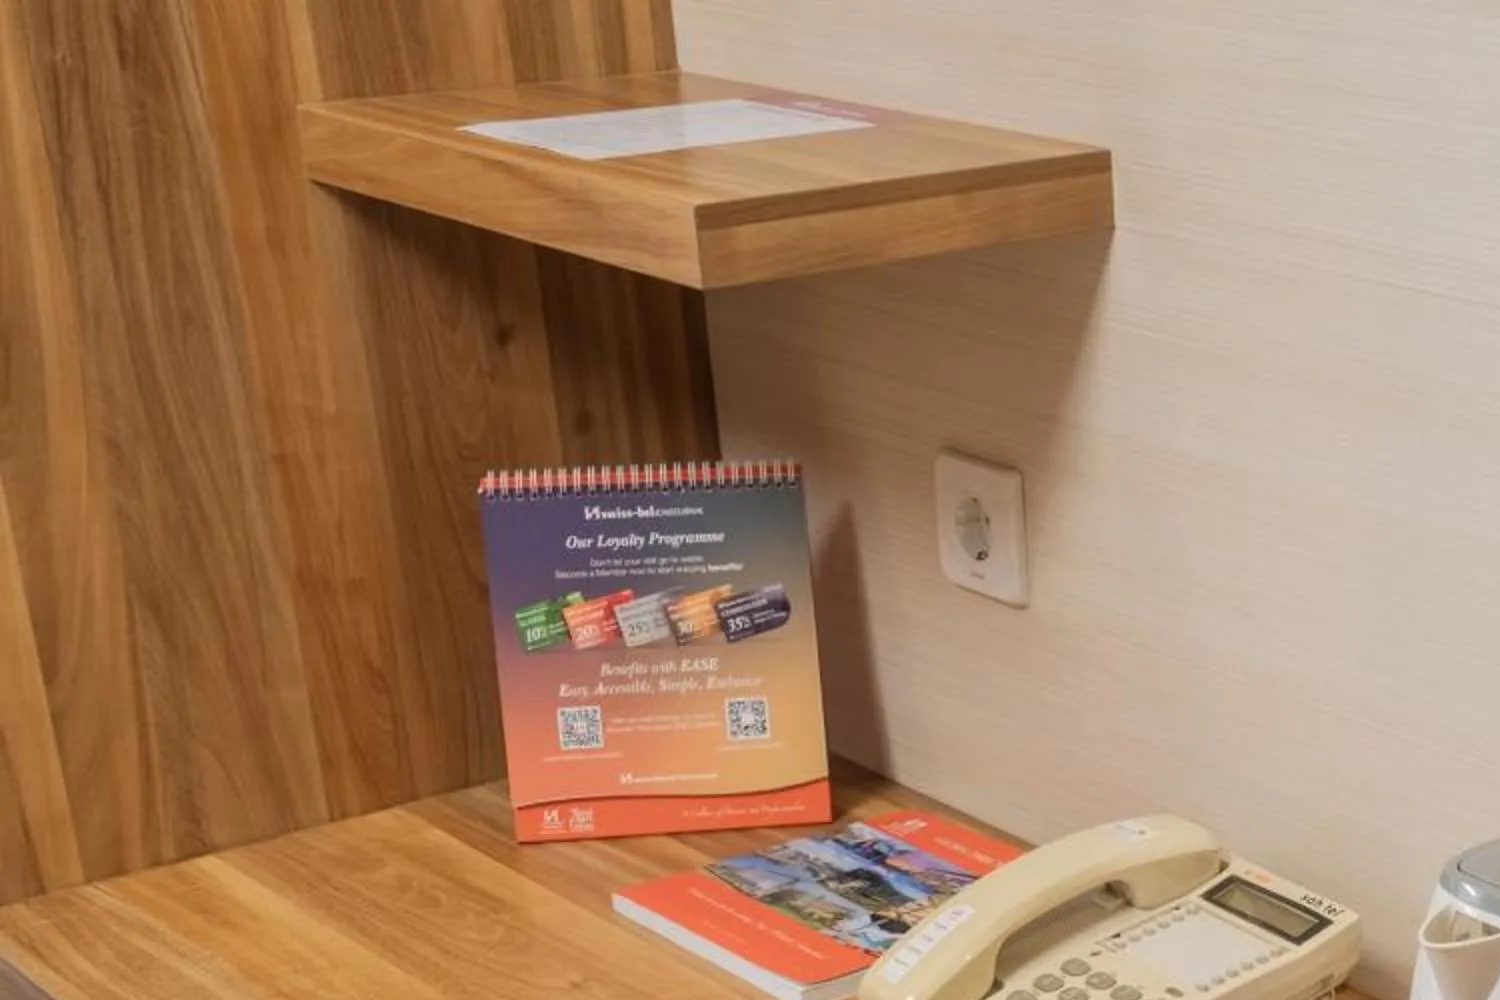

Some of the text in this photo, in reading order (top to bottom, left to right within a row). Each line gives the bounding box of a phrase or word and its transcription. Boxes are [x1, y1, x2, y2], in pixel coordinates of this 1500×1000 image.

[565, 531, 726, 550] Our Loyalty Programme
[680, 657, 720, 673] EASE
